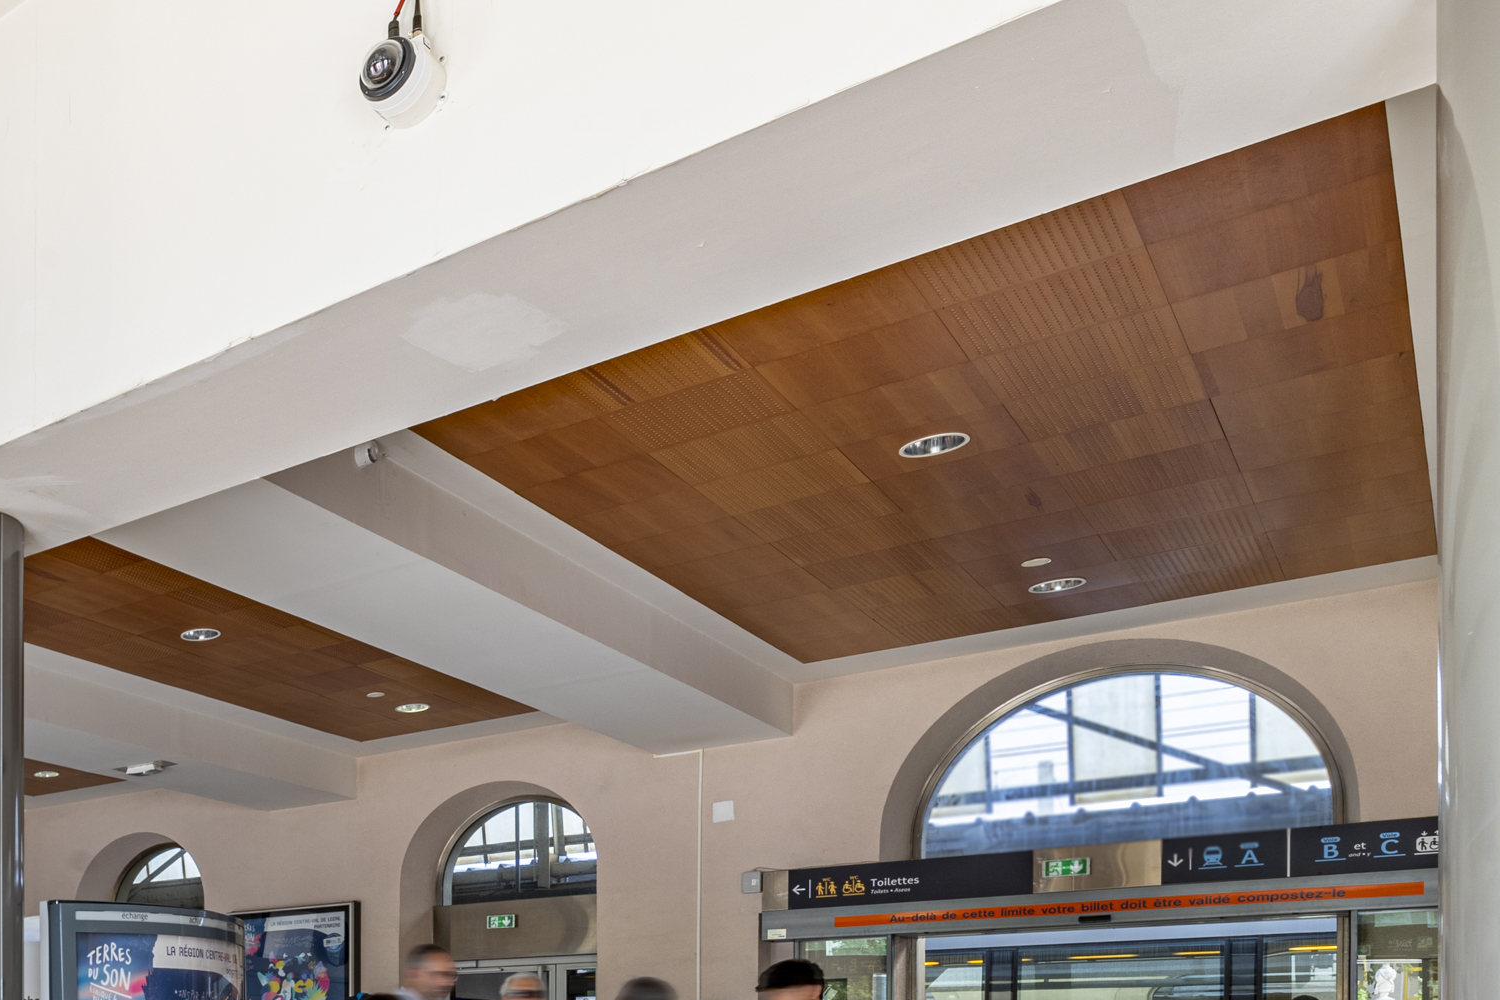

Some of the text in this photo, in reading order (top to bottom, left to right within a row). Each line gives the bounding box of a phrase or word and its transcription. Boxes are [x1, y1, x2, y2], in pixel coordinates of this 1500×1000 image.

[1241, 849, 1259, 864] A
[1323, 839, 1399, 859] B et C
[870, 876, 920, 888] Toilettes
[889, 888, 1346, 923] Au-delà de cette limite votre billet doit être validé compostez-le
[121, 911, 149, 922] échange
[87, 942, 132, 966] TERRES
[166, 946, 176, 956] LA
[179, 944, 204, 959] RÉGION
[88, 964, 131, 991] DU SON
